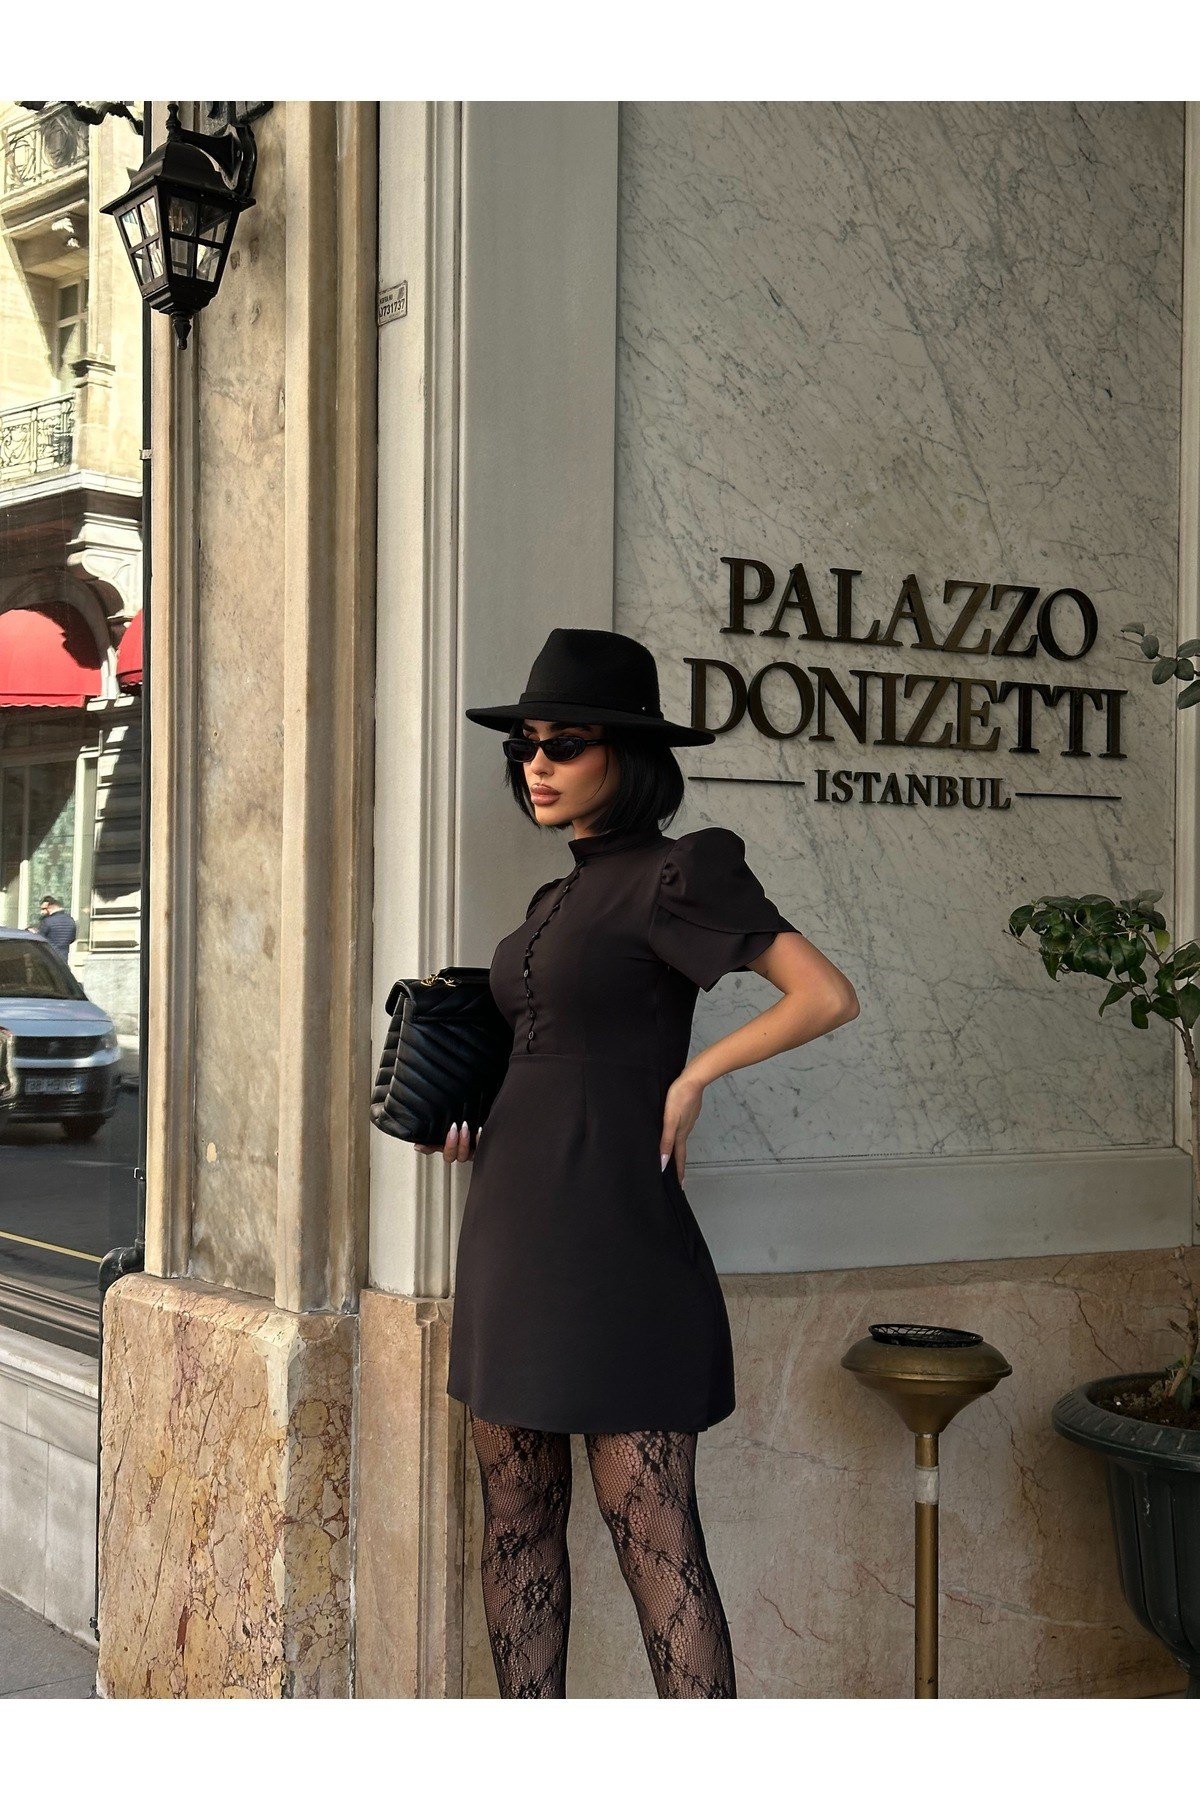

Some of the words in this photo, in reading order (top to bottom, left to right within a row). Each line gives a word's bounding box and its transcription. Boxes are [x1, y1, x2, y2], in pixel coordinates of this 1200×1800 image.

[720, 556, 1098, 661] PALAZZO
[683, 657, 1128, 759] DONIZETTI
[814, 769, 1012, 809] ISTANBUL
